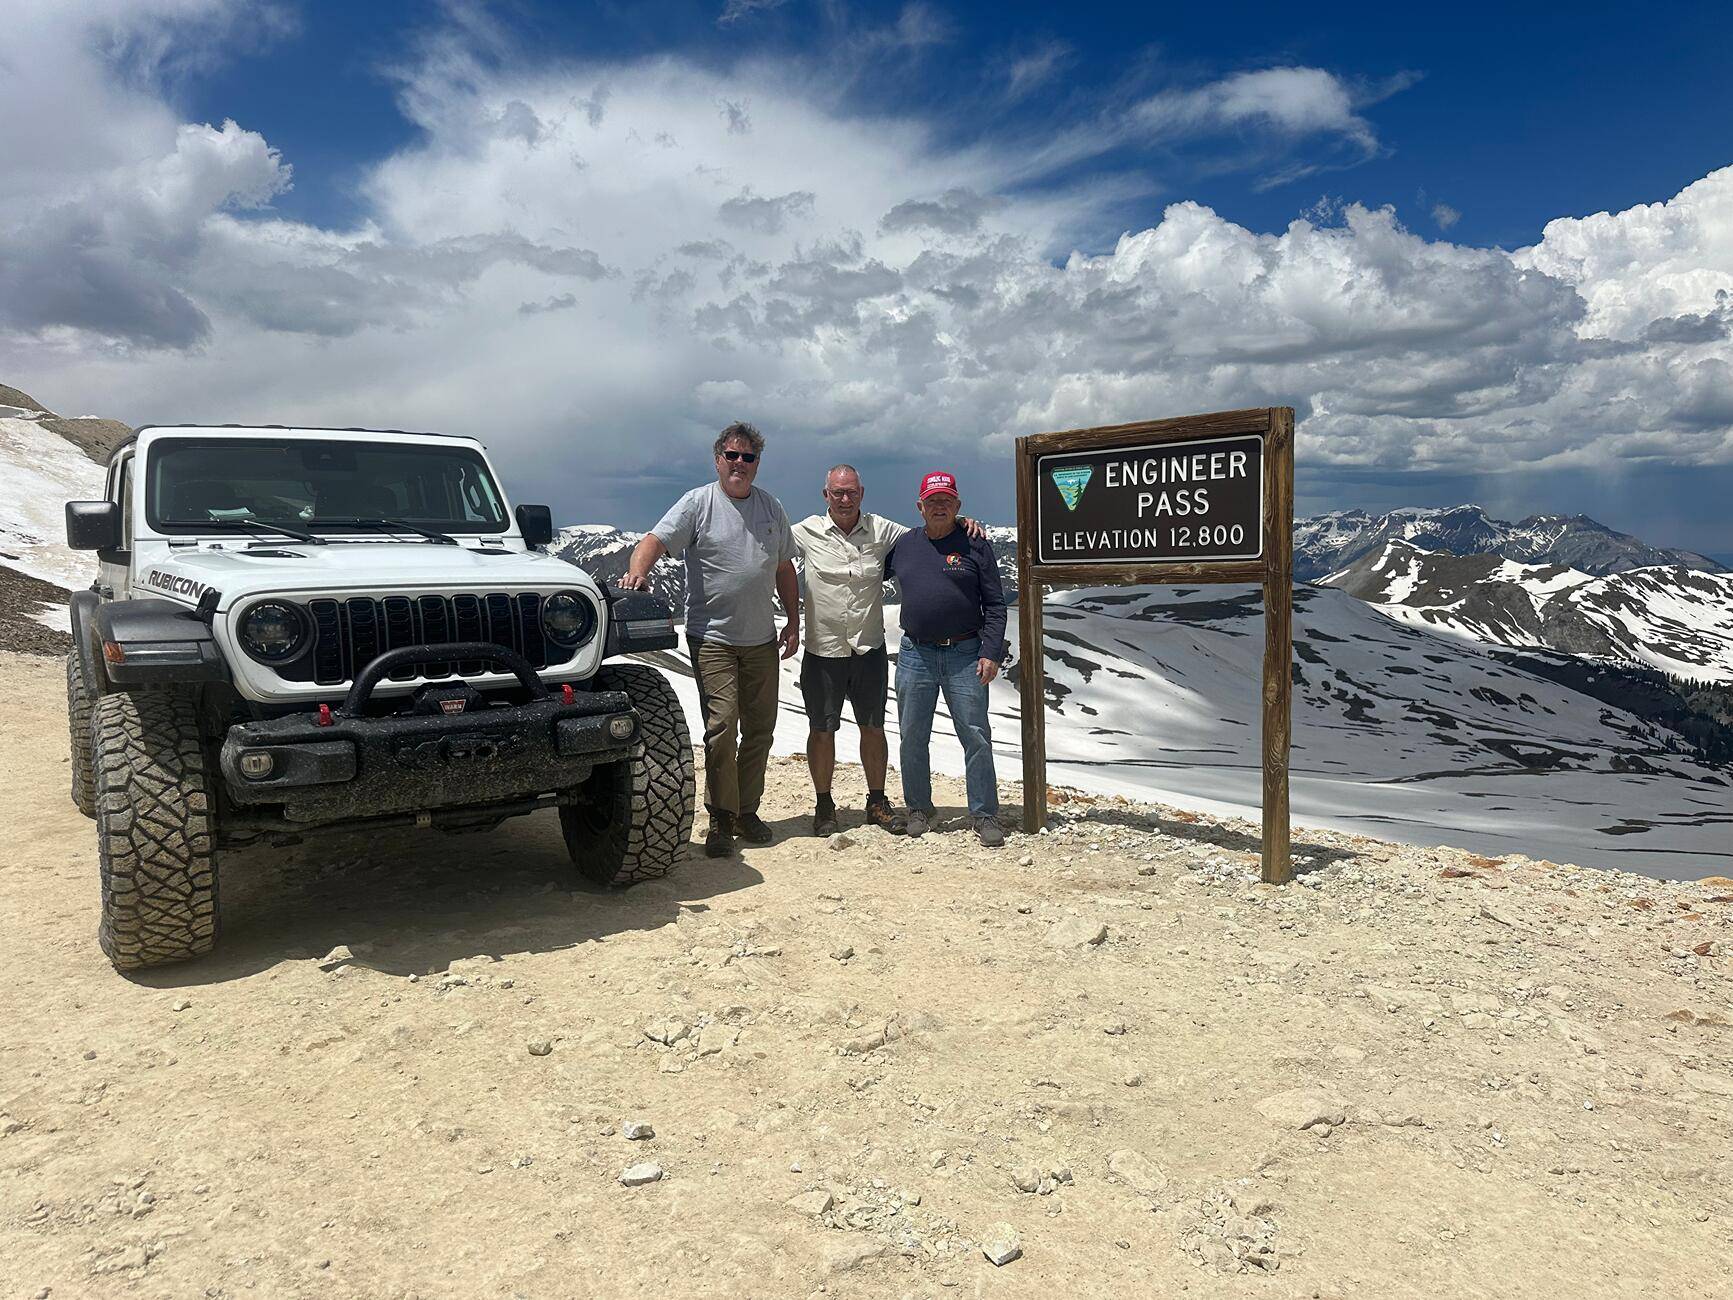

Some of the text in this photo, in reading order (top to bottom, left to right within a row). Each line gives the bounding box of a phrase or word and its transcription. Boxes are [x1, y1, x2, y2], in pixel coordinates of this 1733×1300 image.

[1106, 451, 1247, 487] ENGINEER
[1137, 488, 1210, 517] PASS
[1052, 524, 1244, 550] ELEVATION 12,800
[148, 570, 206, 598] RUBICON
